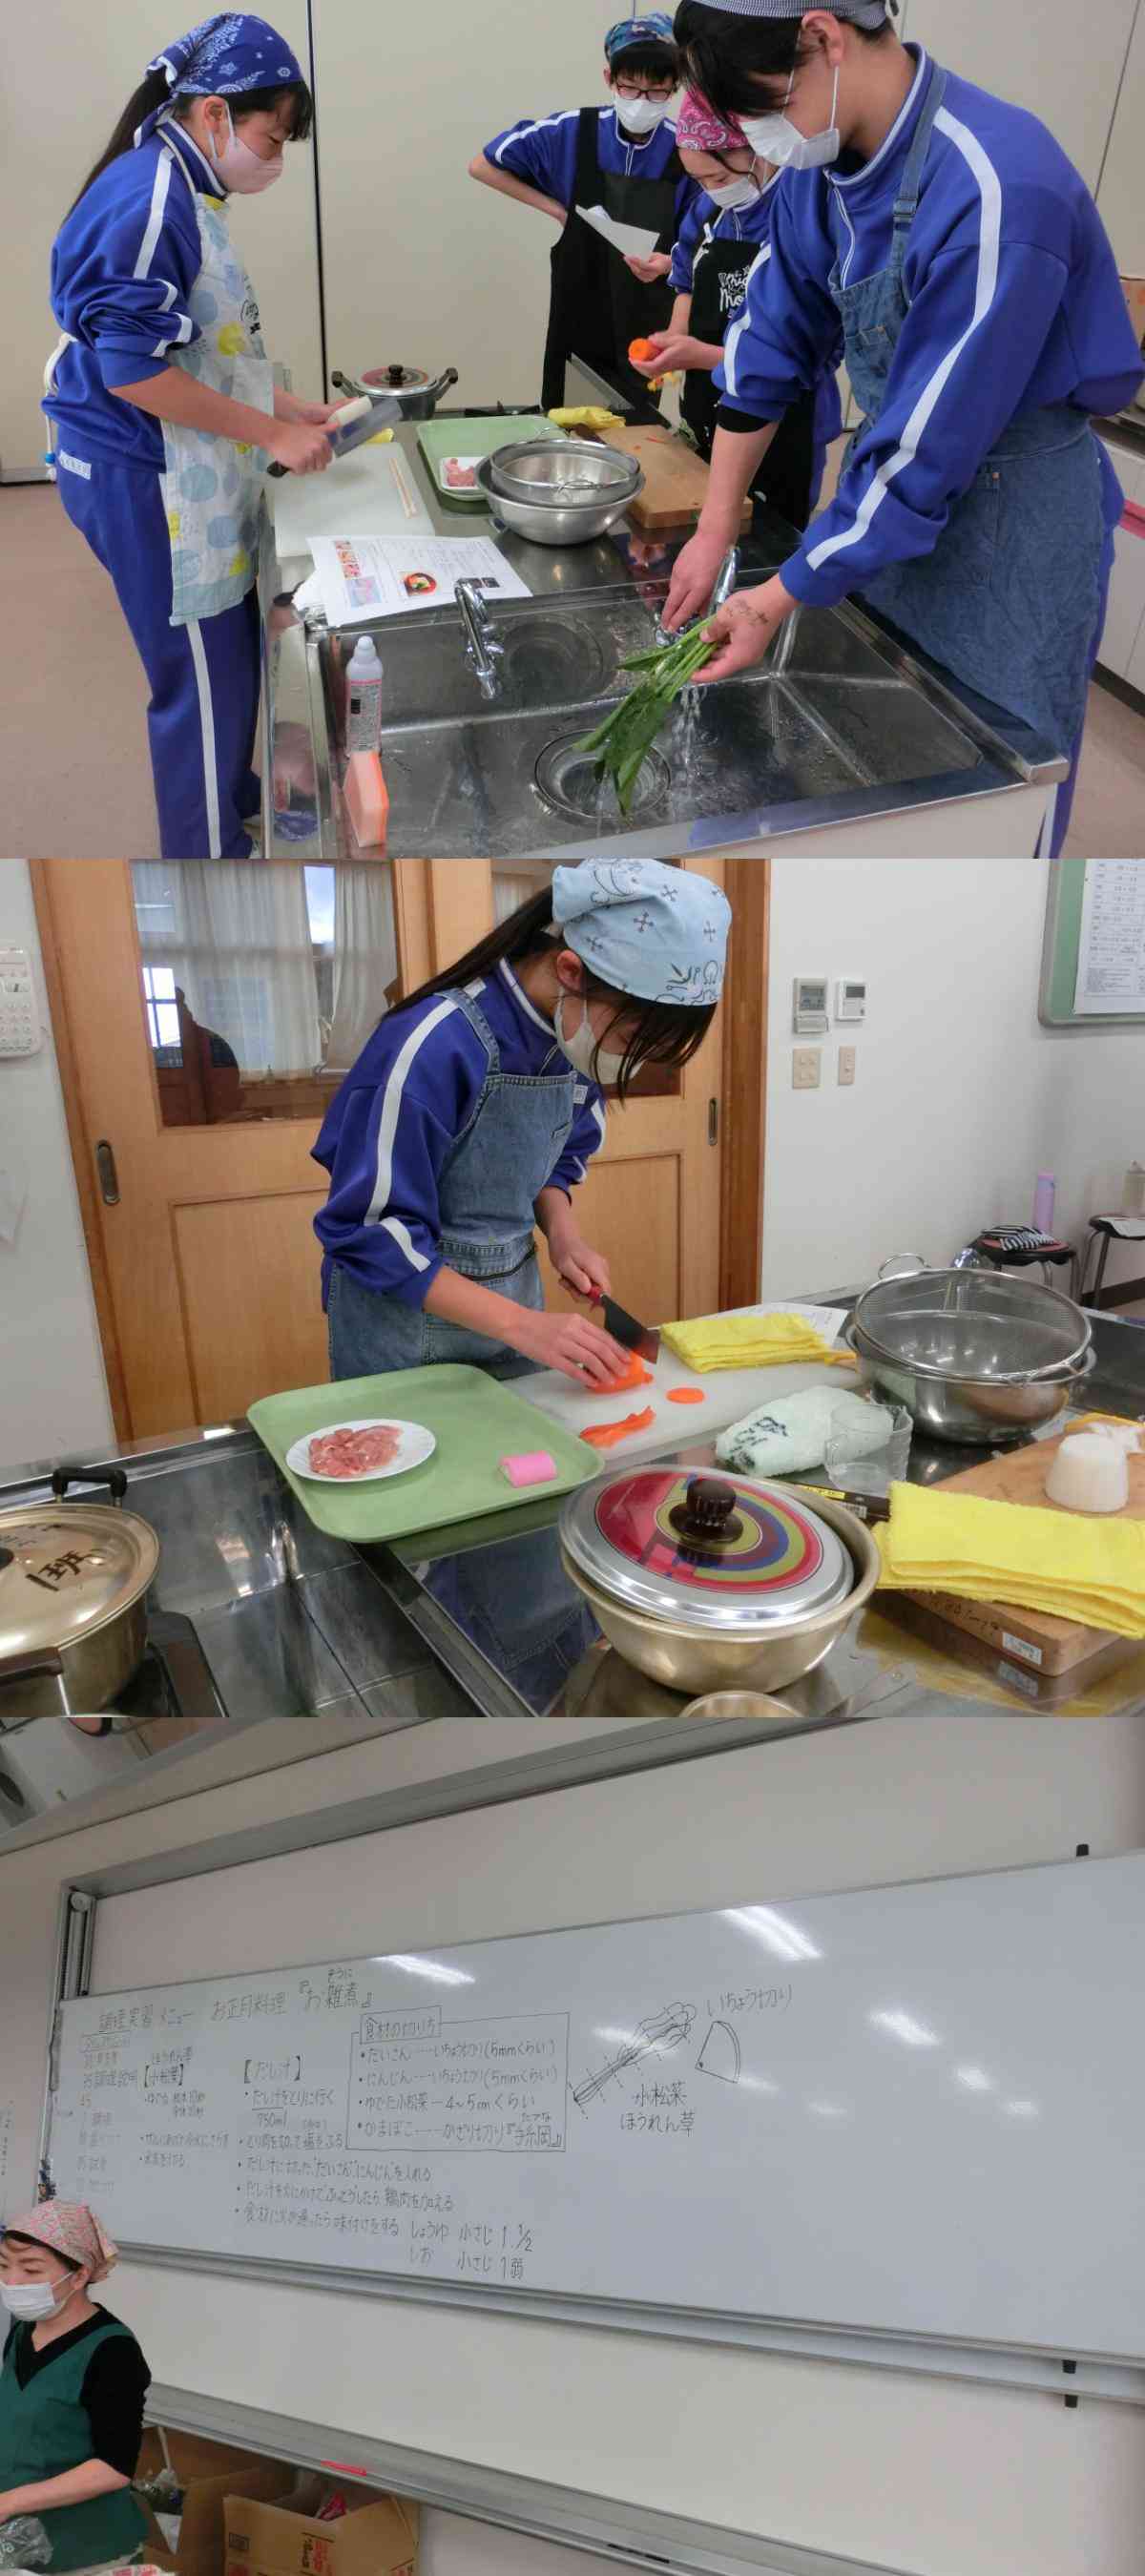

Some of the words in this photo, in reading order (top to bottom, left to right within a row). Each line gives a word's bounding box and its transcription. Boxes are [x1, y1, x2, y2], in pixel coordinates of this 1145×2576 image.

[707, 1984, 793, 2017] いちょう切り
[634, 2080, 688, 2107] 小松菜
[619, 2110, 696, 2137] ほうれん草
[410, 2220, 450, 2242] しょうゆ
[458, 2223, 493, 2247] 小さじ
[457, 2251, 492, 2274] 小さじ
